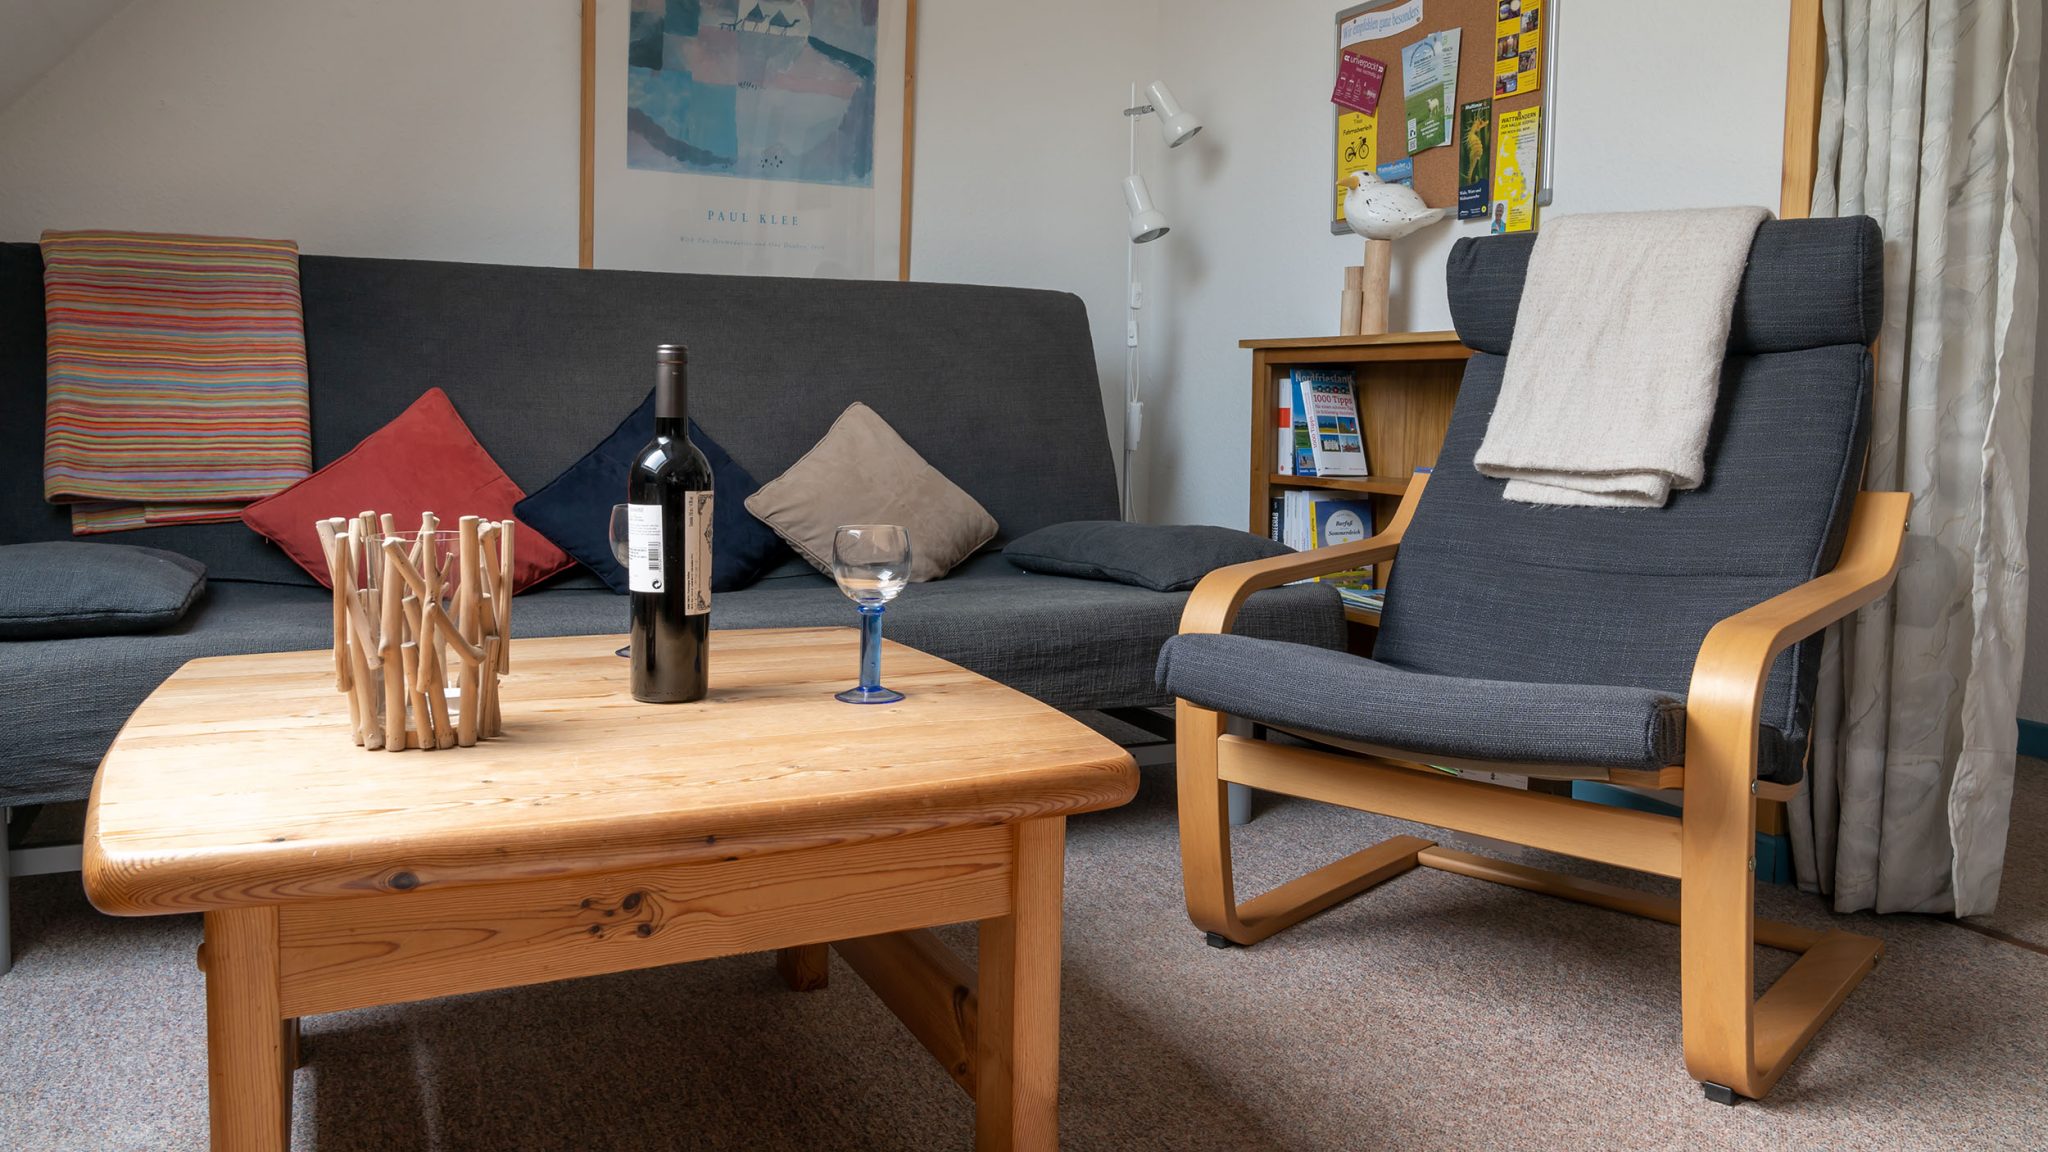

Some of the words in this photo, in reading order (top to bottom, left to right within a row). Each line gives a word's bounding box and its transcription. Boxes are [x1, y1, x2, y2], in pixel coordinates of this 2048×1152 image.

[707, 209, 749, 223] PAUL
[759, 213, 799, 226] KLEE
[1313, 394, 1332, 404] 1000
[1332, 395, 1353, 406] Tipps
